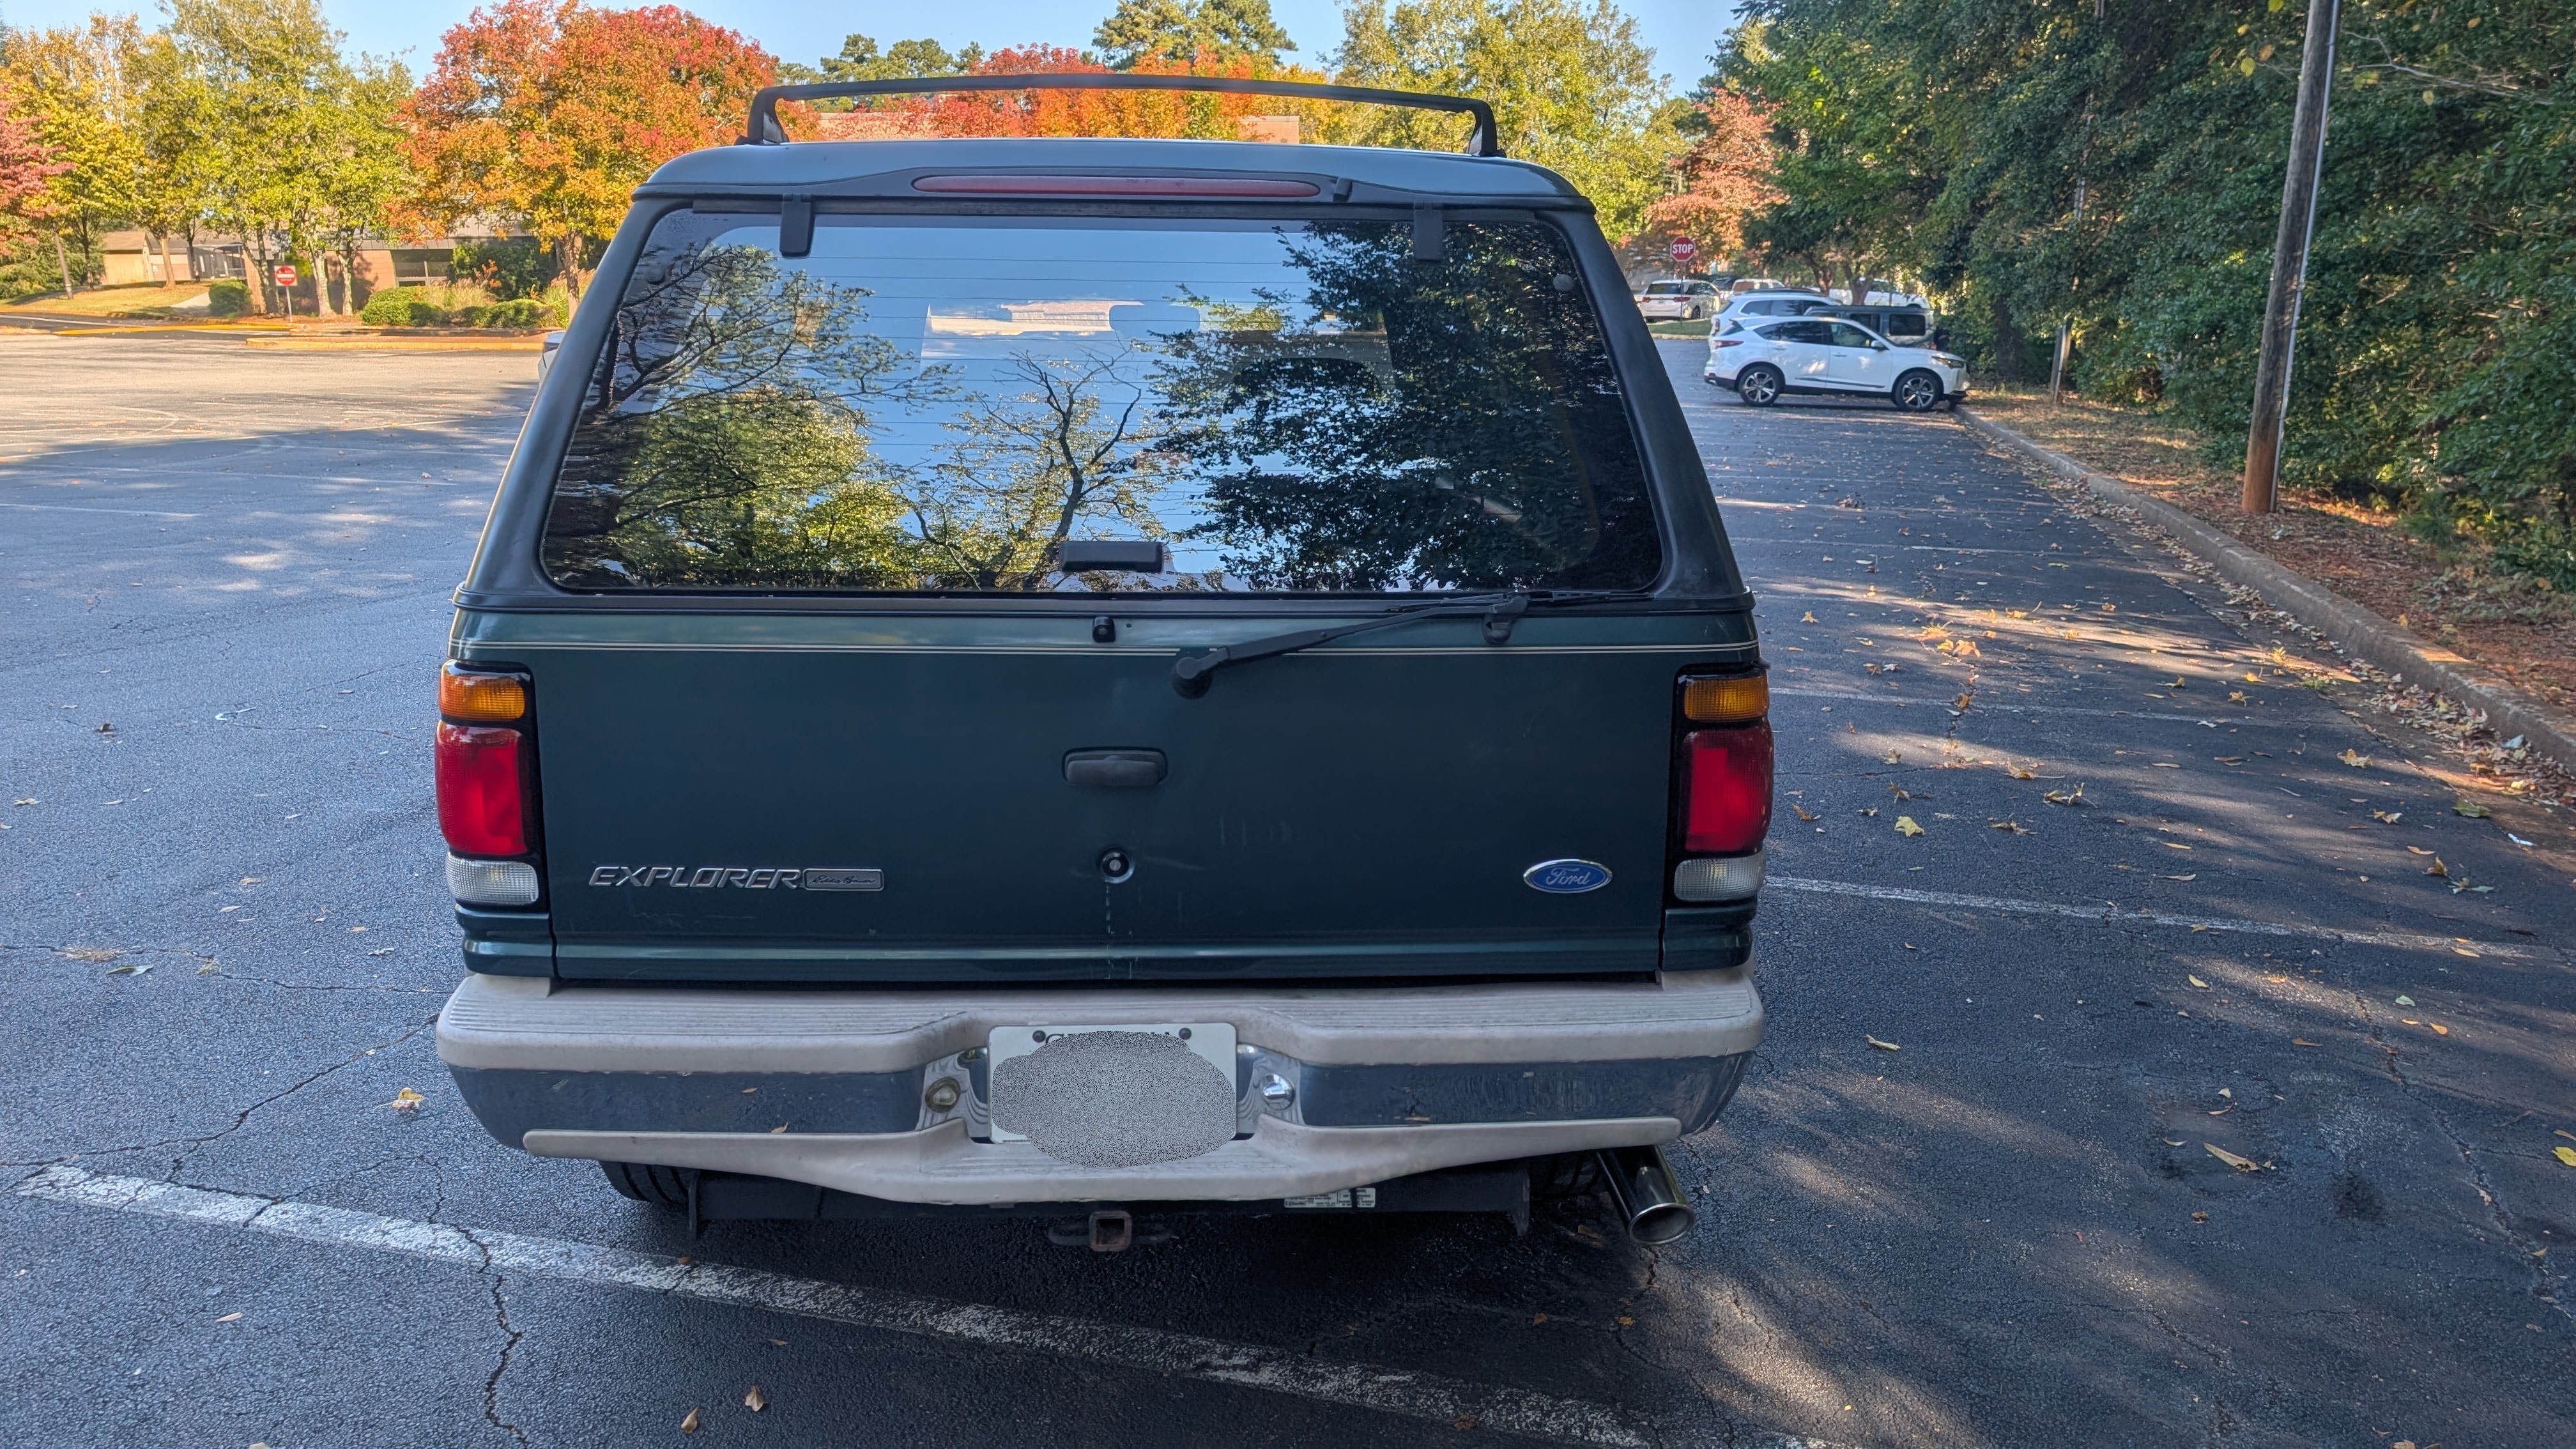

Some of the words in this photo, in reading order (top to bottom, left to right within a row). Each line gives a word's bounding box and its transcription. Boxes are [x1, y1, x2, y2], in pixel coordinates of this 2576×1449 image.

[1672, 243, 1694, 254] STOP
[588, 866, 801, 889] EXPLORER
[1545, 868, 1591, 885] Ford
